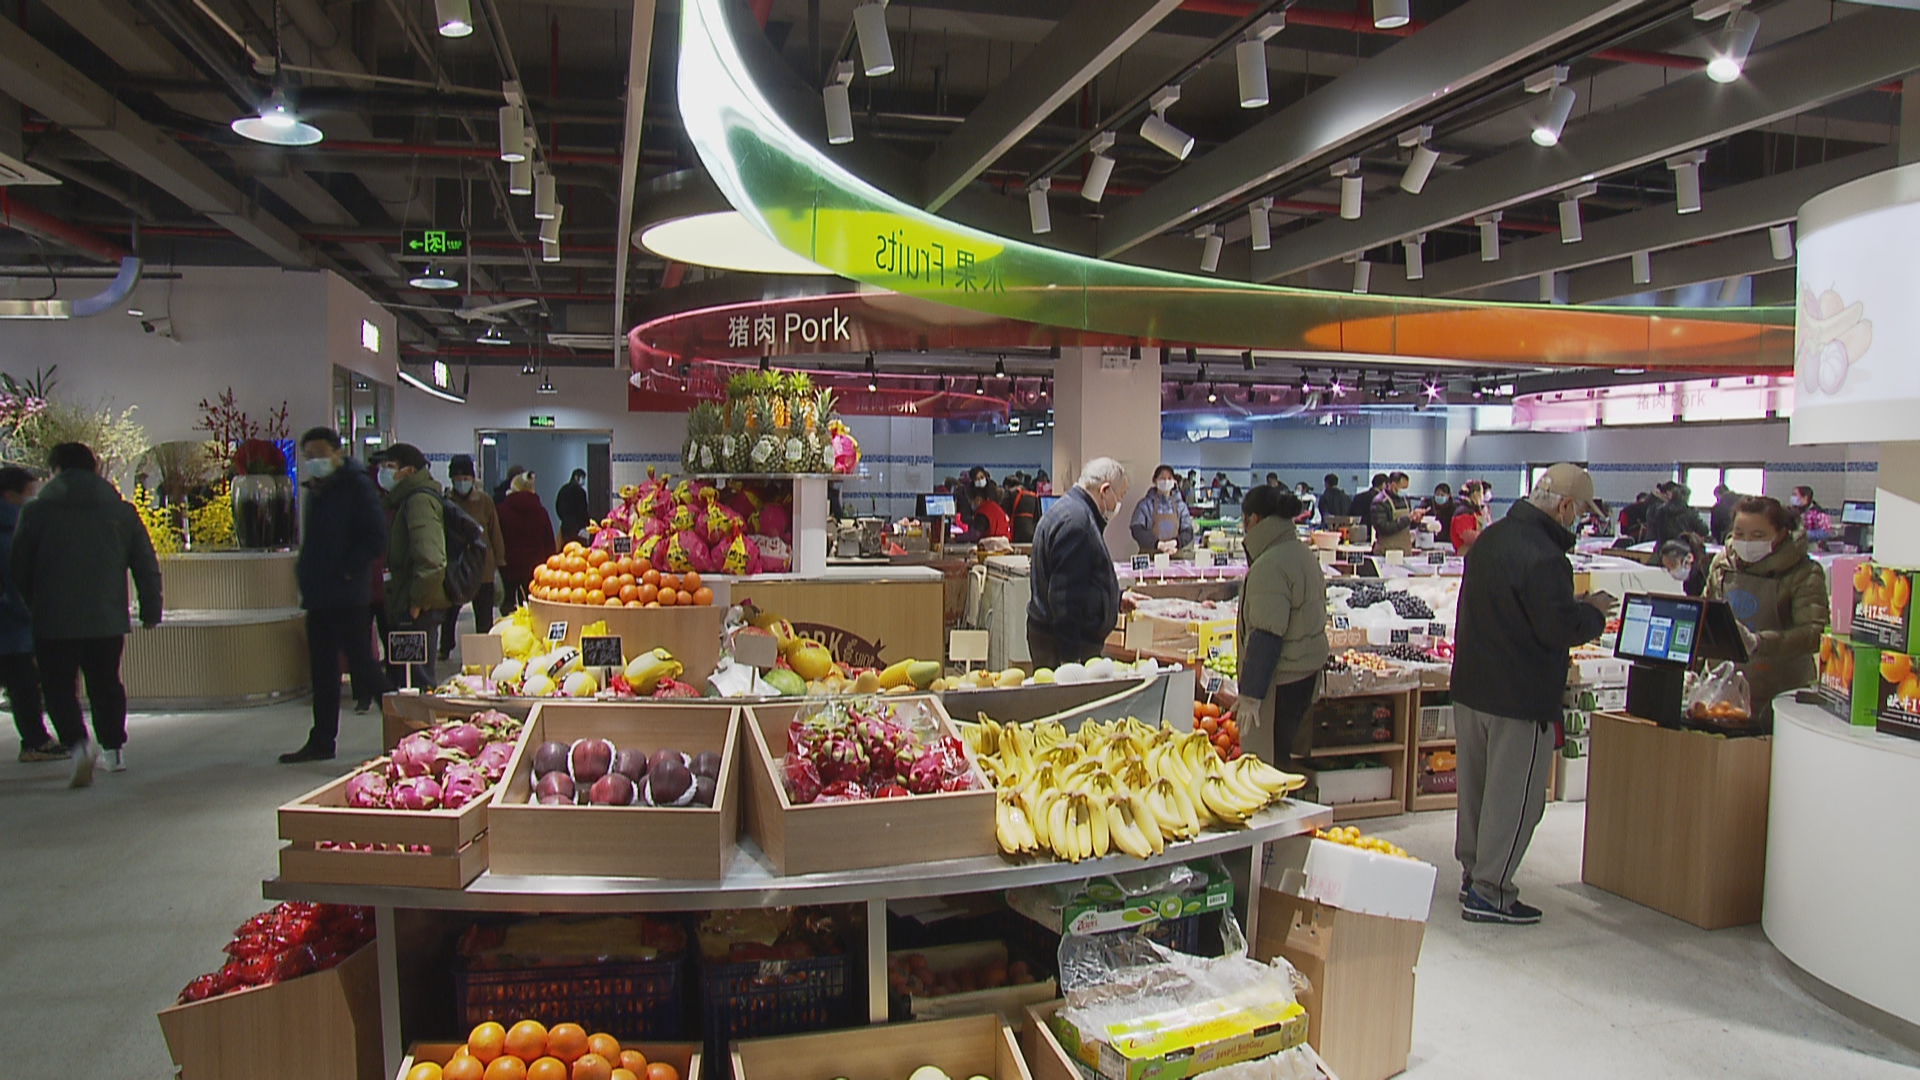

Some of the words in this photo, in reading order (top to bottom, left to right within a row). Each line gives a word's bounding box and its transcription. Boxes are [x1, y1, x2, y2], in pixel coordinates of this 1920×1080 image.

[728, 313, 776, 348] 猪肉
[784, 307, 850, 343] Pork
[1671, 389, 1706, 408] Pork
[853, 651, 875, 668] SHOP
